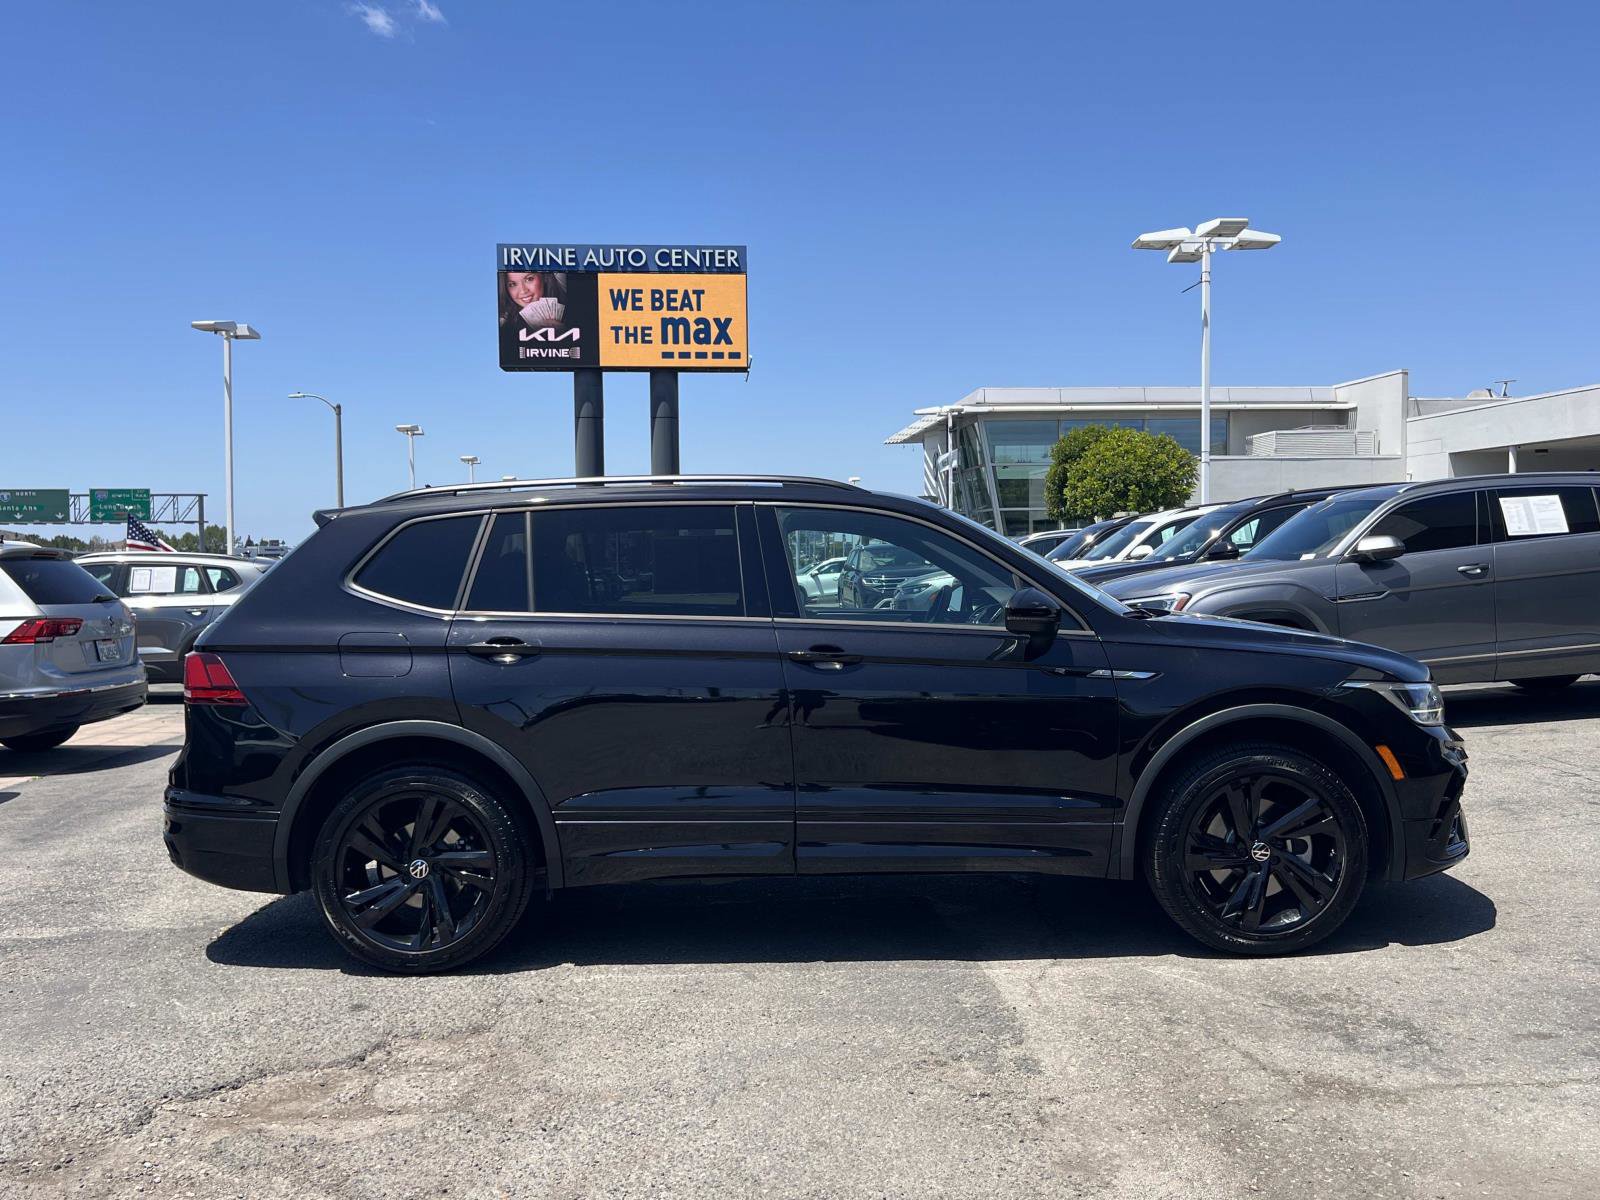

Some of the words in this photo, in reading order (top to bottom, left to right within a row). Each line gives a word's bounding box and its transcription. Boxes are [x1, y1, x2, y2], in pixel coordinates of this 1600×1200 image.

[502, 247, 576, 267] IRVINE
[584, 248, 647, 267] AUTO
[654, 249, 740, 267] CENTER
[609, 288, 644, 312] WE
[650, 289, 706, 312] BEAT
[518, 327, 581, 342] KIA
[610, 325, 653, 345] THE
[660, 316, 734, 346] max
[526, 348, 571, 358] IRVINE
